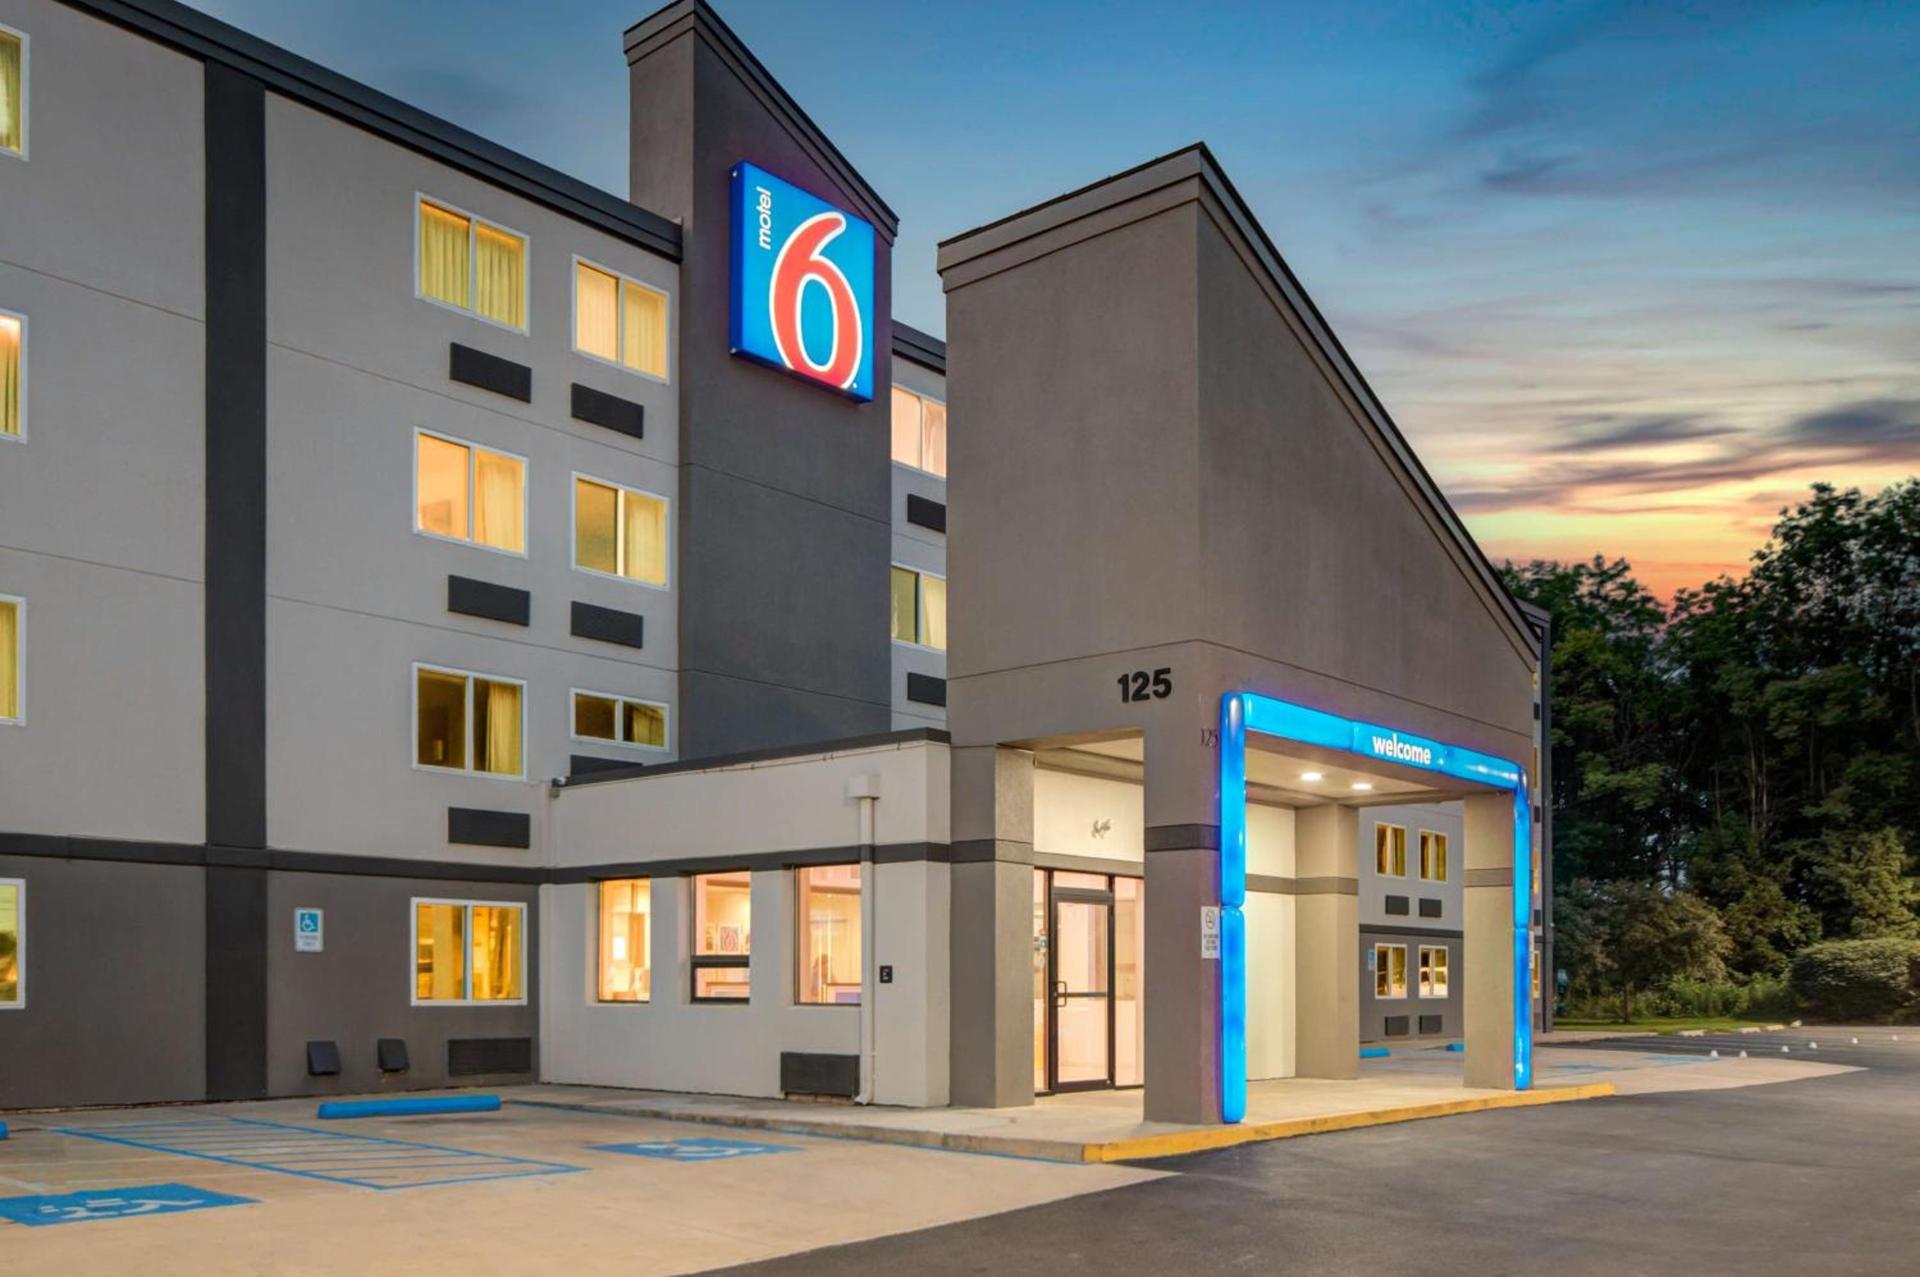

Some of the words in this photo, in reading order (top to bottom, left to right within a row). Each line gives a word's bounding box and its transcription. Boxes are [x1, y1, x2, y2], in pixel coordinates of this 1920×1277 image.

[756, 186, 771, 251] motel
[769, 211, 862, 389] 6
[1117, 667, 1172, 704] 125
[1372, 733, 1431, 765] welcome
